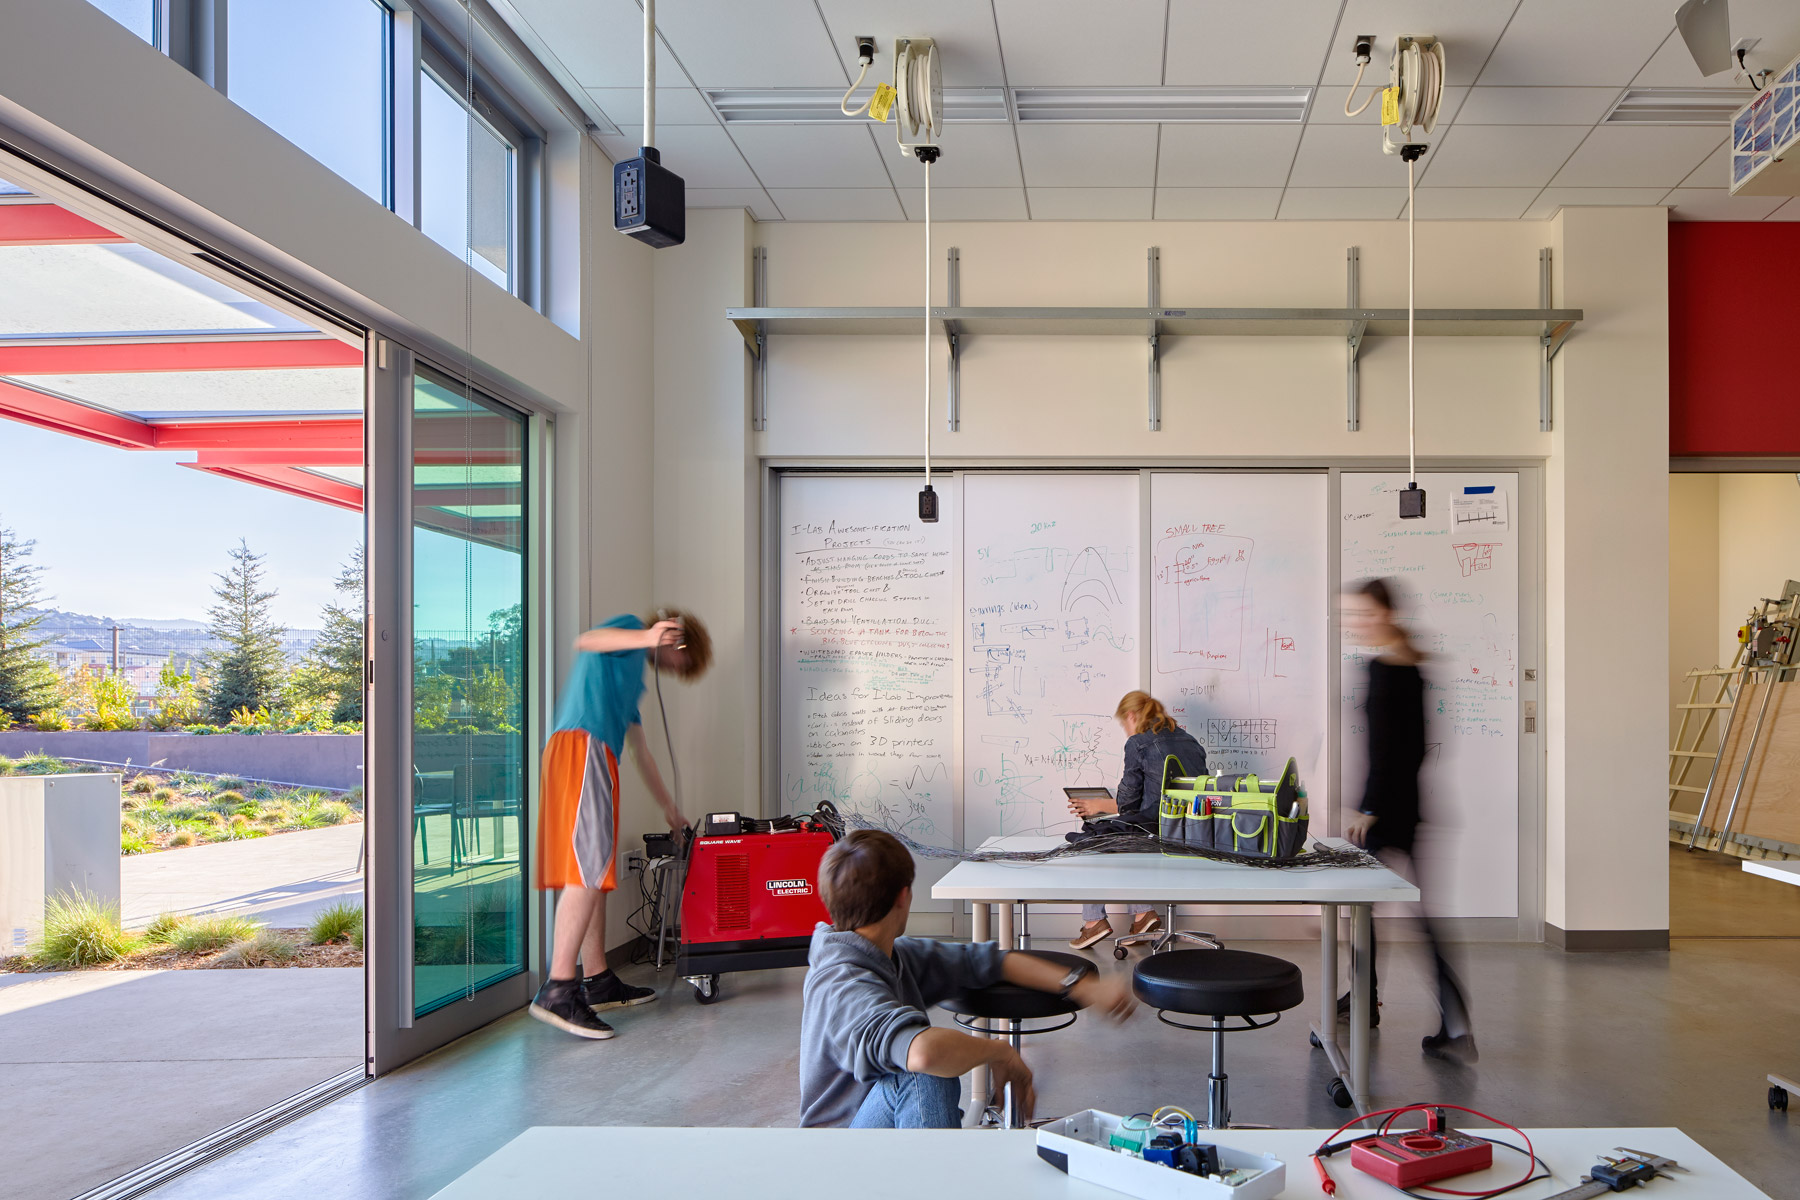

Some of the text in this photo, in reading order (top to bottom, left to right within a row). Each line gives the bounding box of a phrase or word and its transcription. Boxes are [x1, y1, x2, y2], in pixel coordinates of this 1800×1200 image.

[806, 556, 835, 566] ADJUST
[807, 686, 848, 702] Ideas
[851, 686, 875, 700] for
[867, 717, 879, 725] of
[883, 714, 914, 728] Sliding
[917, 713, 943, 723] doors
[870, 735, 888, 747] 3D
[891, 738, 935, 750] printers
[768, 880, 805, 889] LINCOLN
